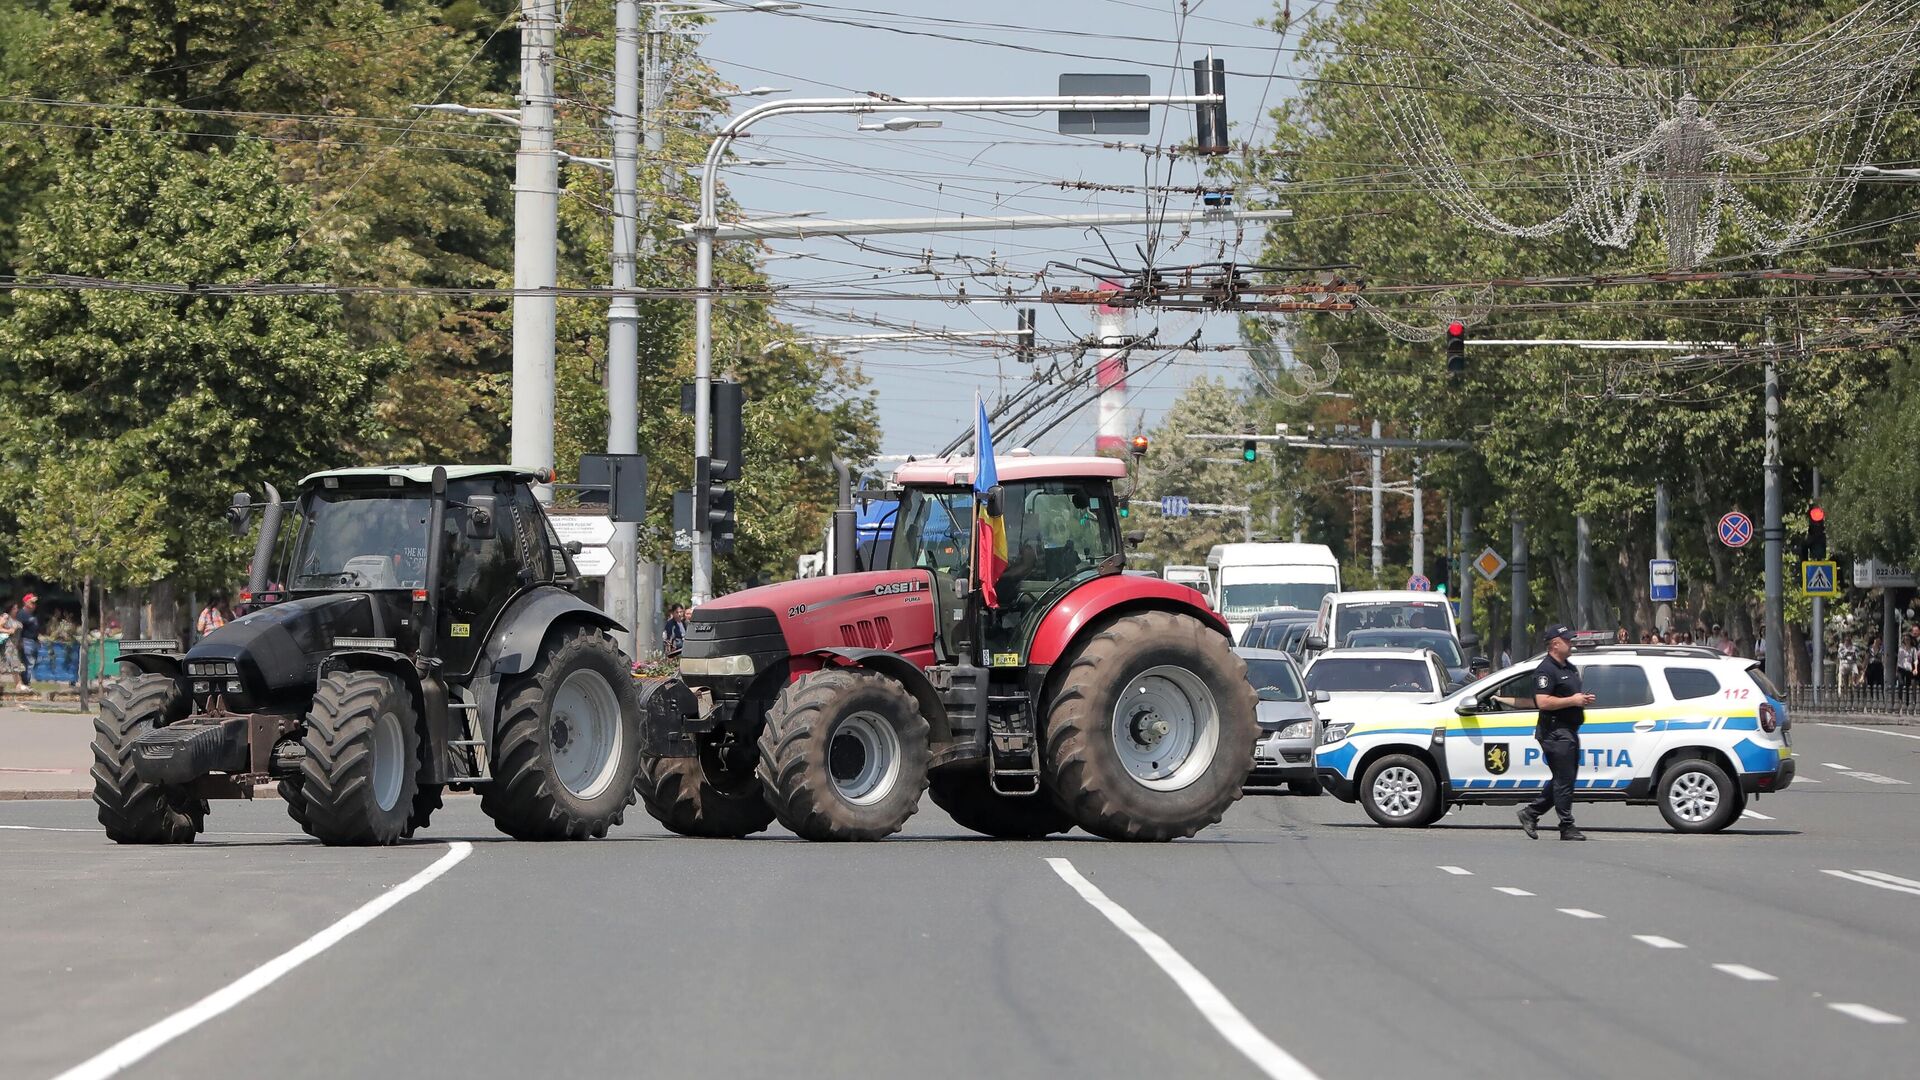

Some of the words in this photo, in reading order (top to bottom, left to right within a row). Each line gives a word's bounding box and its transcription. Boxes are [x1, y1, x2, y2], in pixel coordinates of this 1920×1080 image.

[875, 583, 908, 596] CASE
[789, 604, 806, 618] 210
[1724, 688, 1750, 700] 112
[1524, 747, 1633, 773] PIȚIA
